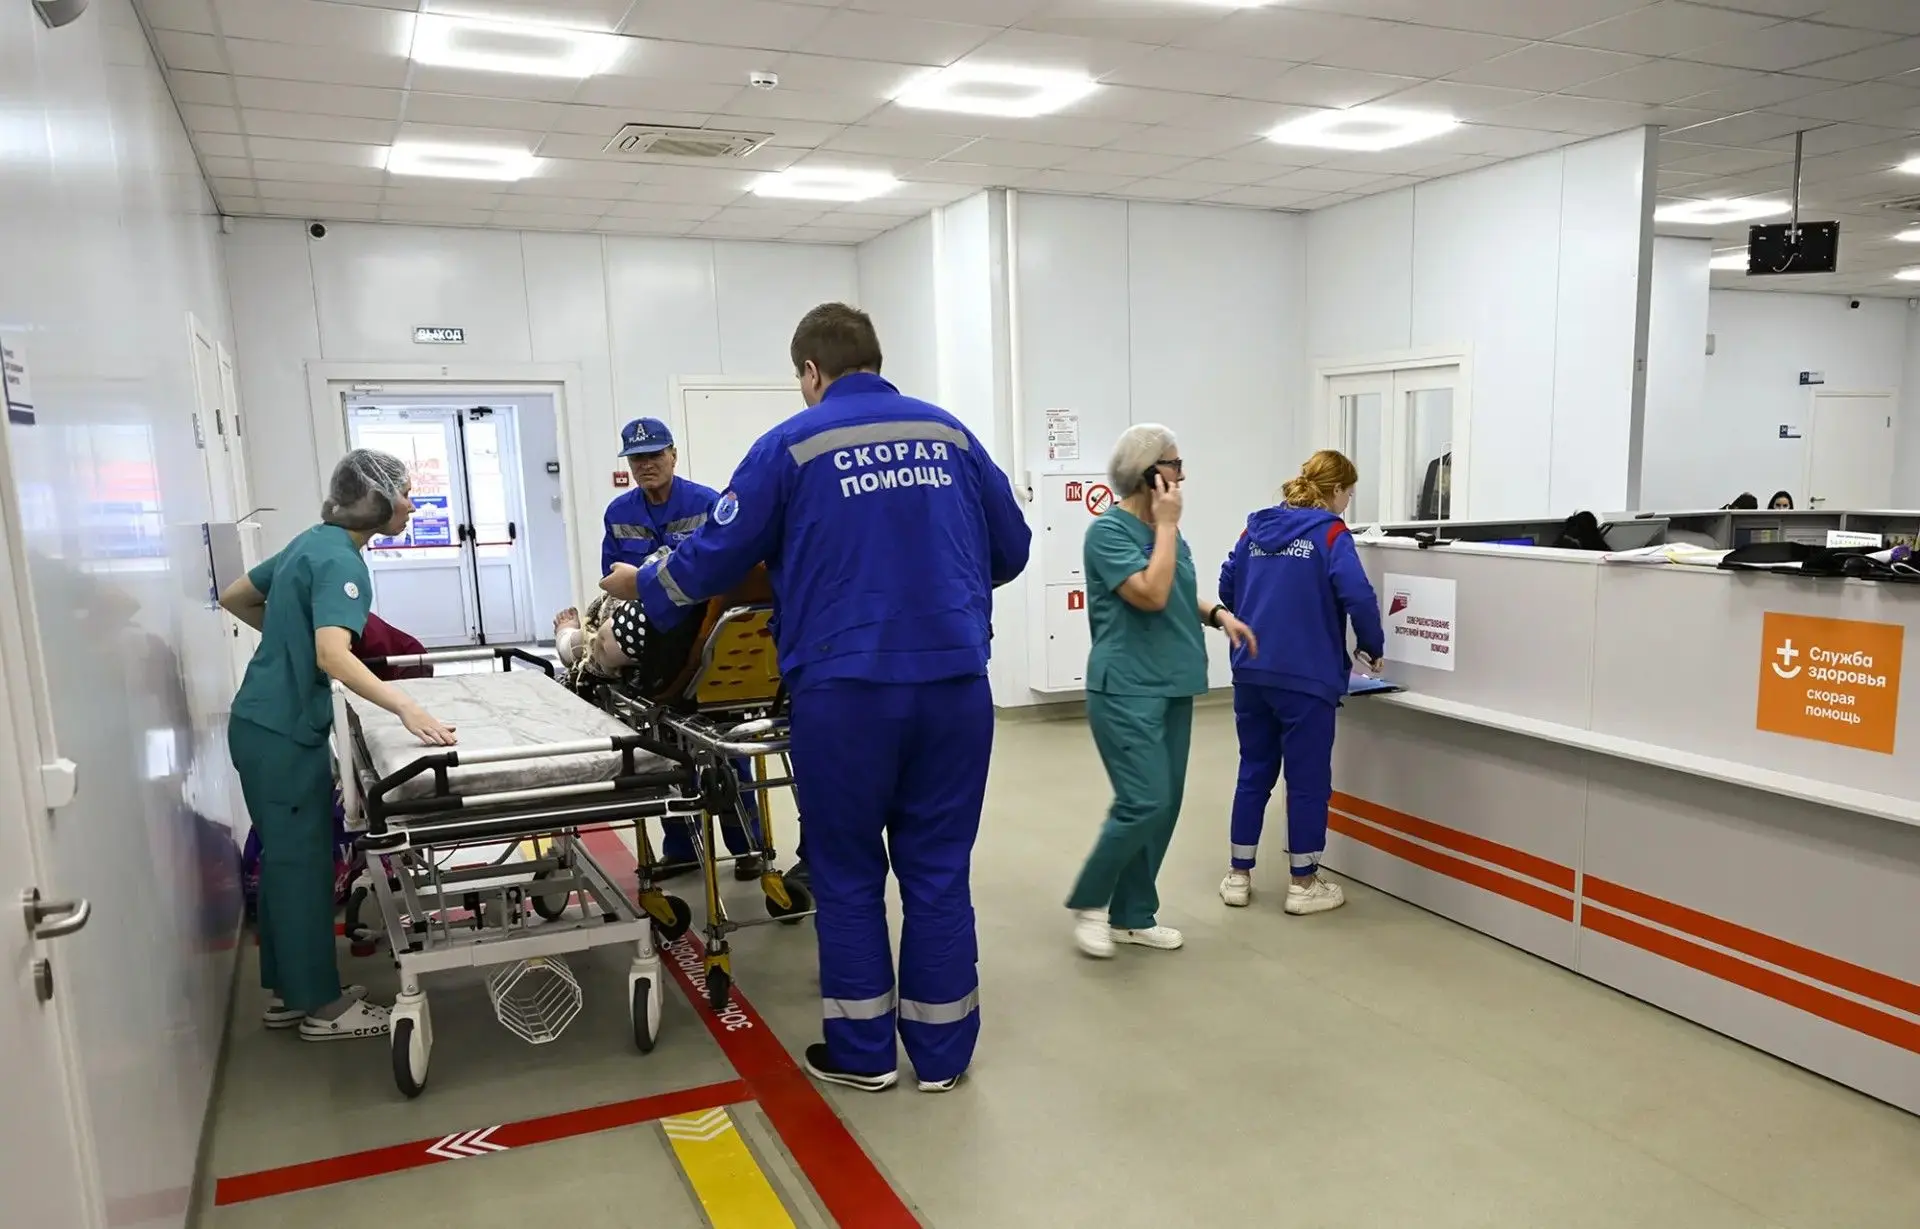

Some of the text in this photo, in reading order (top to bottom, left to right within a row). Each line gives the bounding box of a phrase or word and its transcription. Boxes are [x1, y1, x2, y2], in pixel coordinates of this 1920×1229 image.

[417, 328, 462, 341] ВЫХОД
[833, 442, 949, 471] СКОРАЯ
[839, 466, 953, 498] ПОМОЩЬ
[1067, 485, 1081, 500] ПК
[1290, 538, 1314, 550] ОЩЬ
[1809, 646, 1874, 669] Служба
[1807, 665, 1888, 688] здоровья
[1806, 688, 1857, 706] скорая
[1805, 704, 1862, 725] помощь
[354, 1024, 389, 1036] croc
